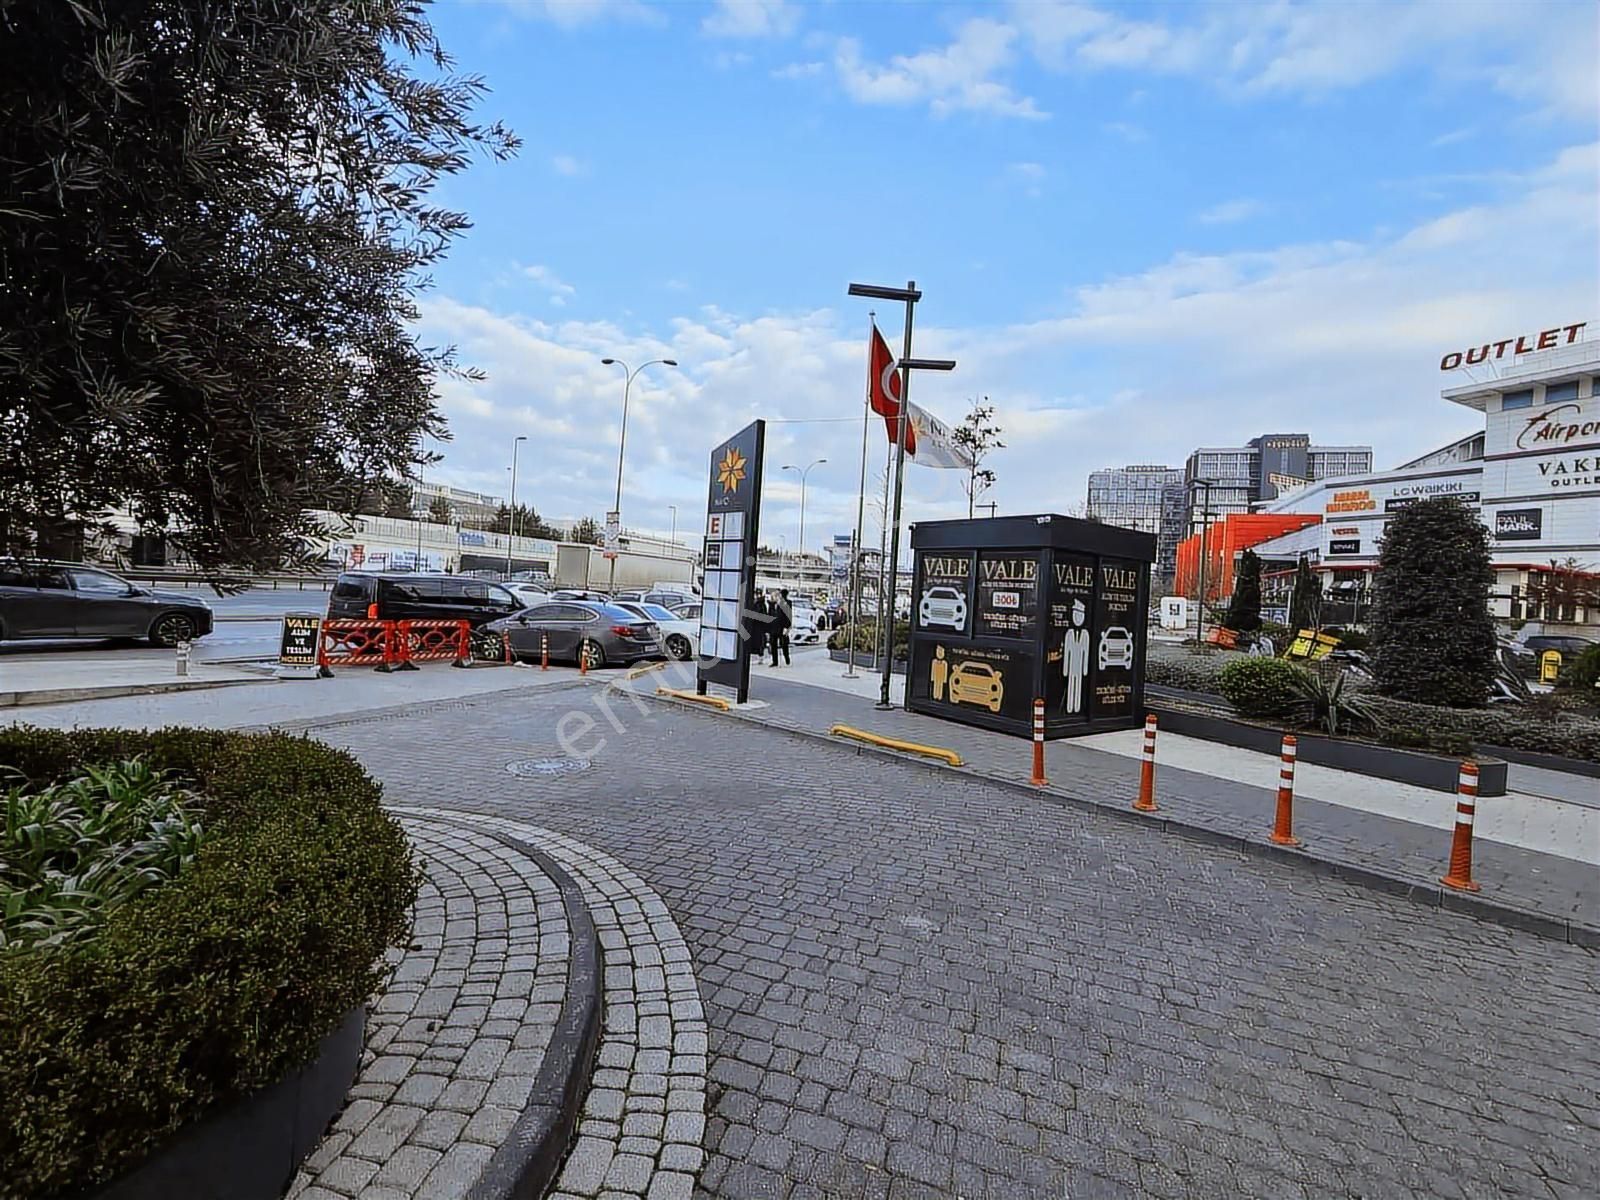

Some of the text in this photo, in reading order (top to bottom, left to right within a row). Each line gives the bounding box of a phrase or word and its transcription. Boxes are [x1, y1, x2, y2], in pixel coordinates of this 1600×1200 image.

[1440, 322, 1587, 371] OUTLET
[711, 517, 720, 534] E
[924, 558, 969, 577] VALE
[982, 560, 1037, 580] VALE
[1055, 564, 1094, 587] VALE
[1102, 568, 1137, 590] VALE
[286, 618, 319, 628] VALE
